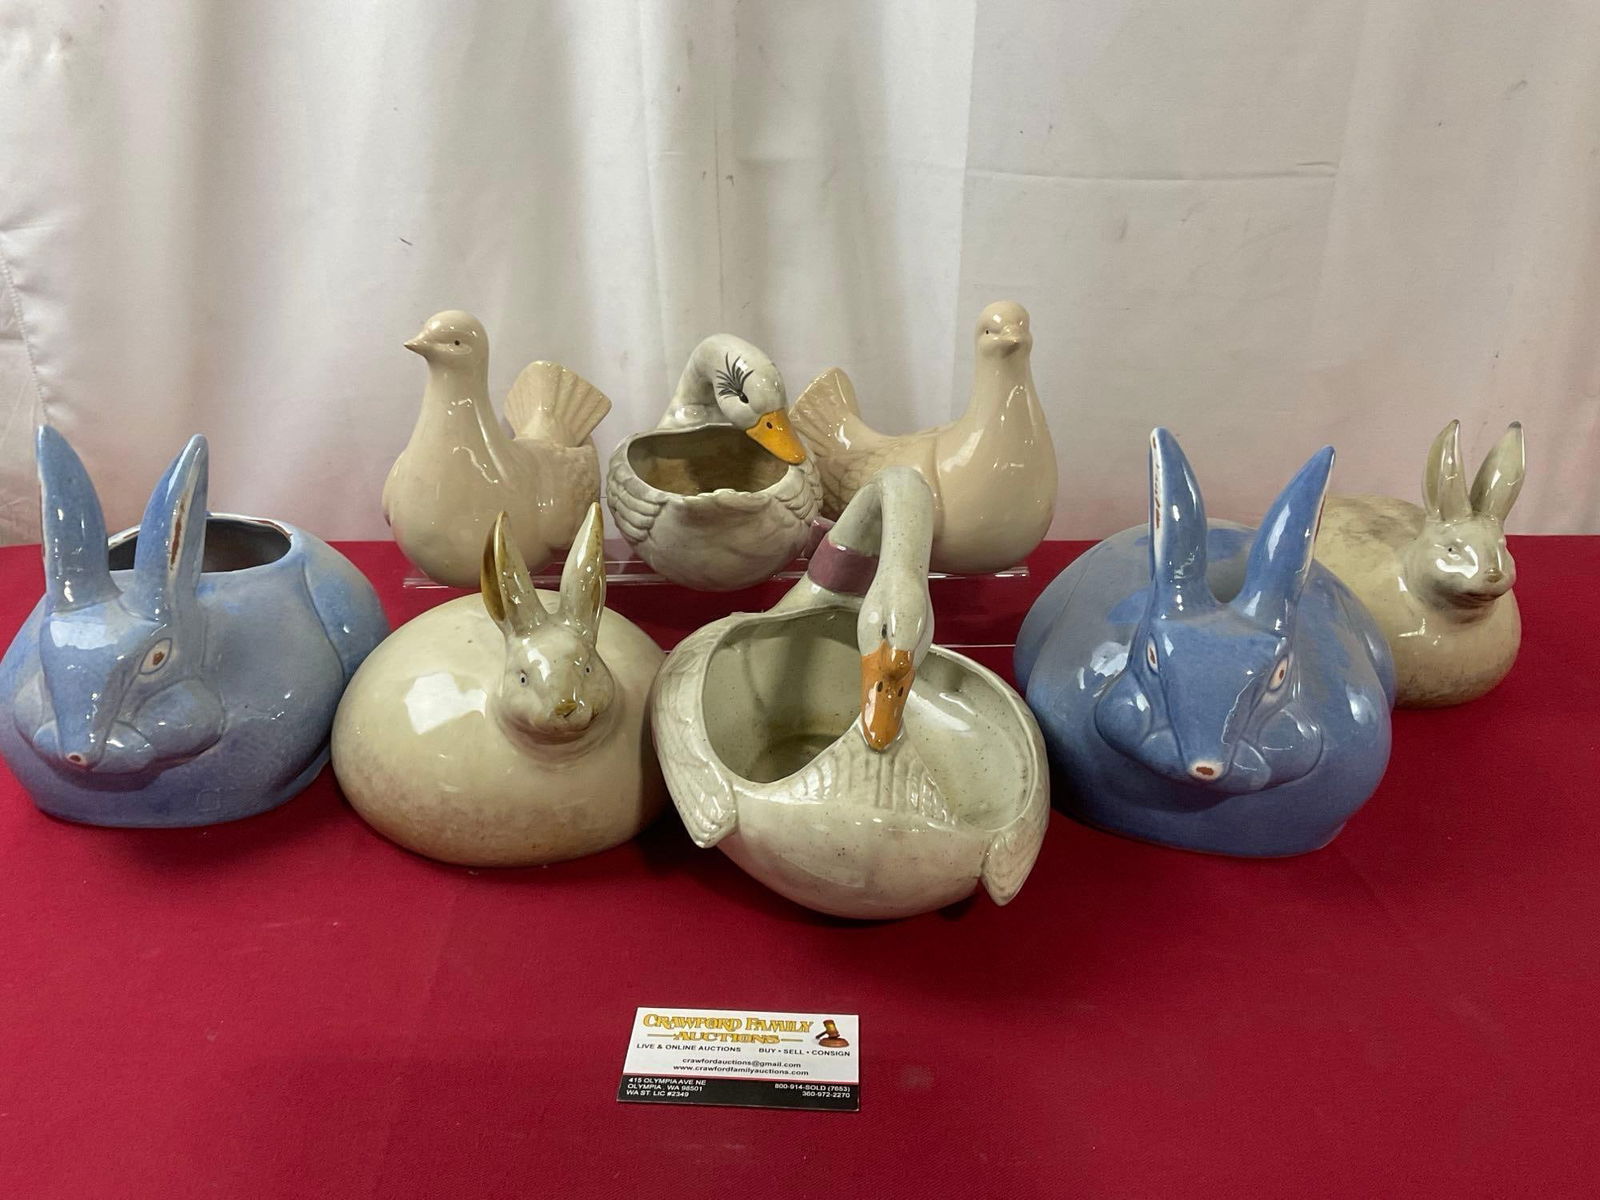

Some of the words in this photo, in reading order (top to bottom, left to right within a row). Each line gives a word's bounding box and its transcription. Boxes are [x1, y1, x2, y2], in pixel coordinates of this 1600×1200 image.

[643, 1013, 742, 1032] CRAWFORD
[745, 1017, 814, 1033] FAMILY
[673, 1031, 780, 1044] AUCTIONS
[811, 1049, 851, 1057] CONSIGN
[682, 1058, 802, 1068] crawfordauctions@gmail.com
[673, 1065, 809, 1076] www.crawfordfamilyauctions.com
[774, 1083, 826, 1091] 800-914-SOLD
[827, 1085, 851, 1093] (7653)
[802, 1090, 851, 1098] 360-972-2270
